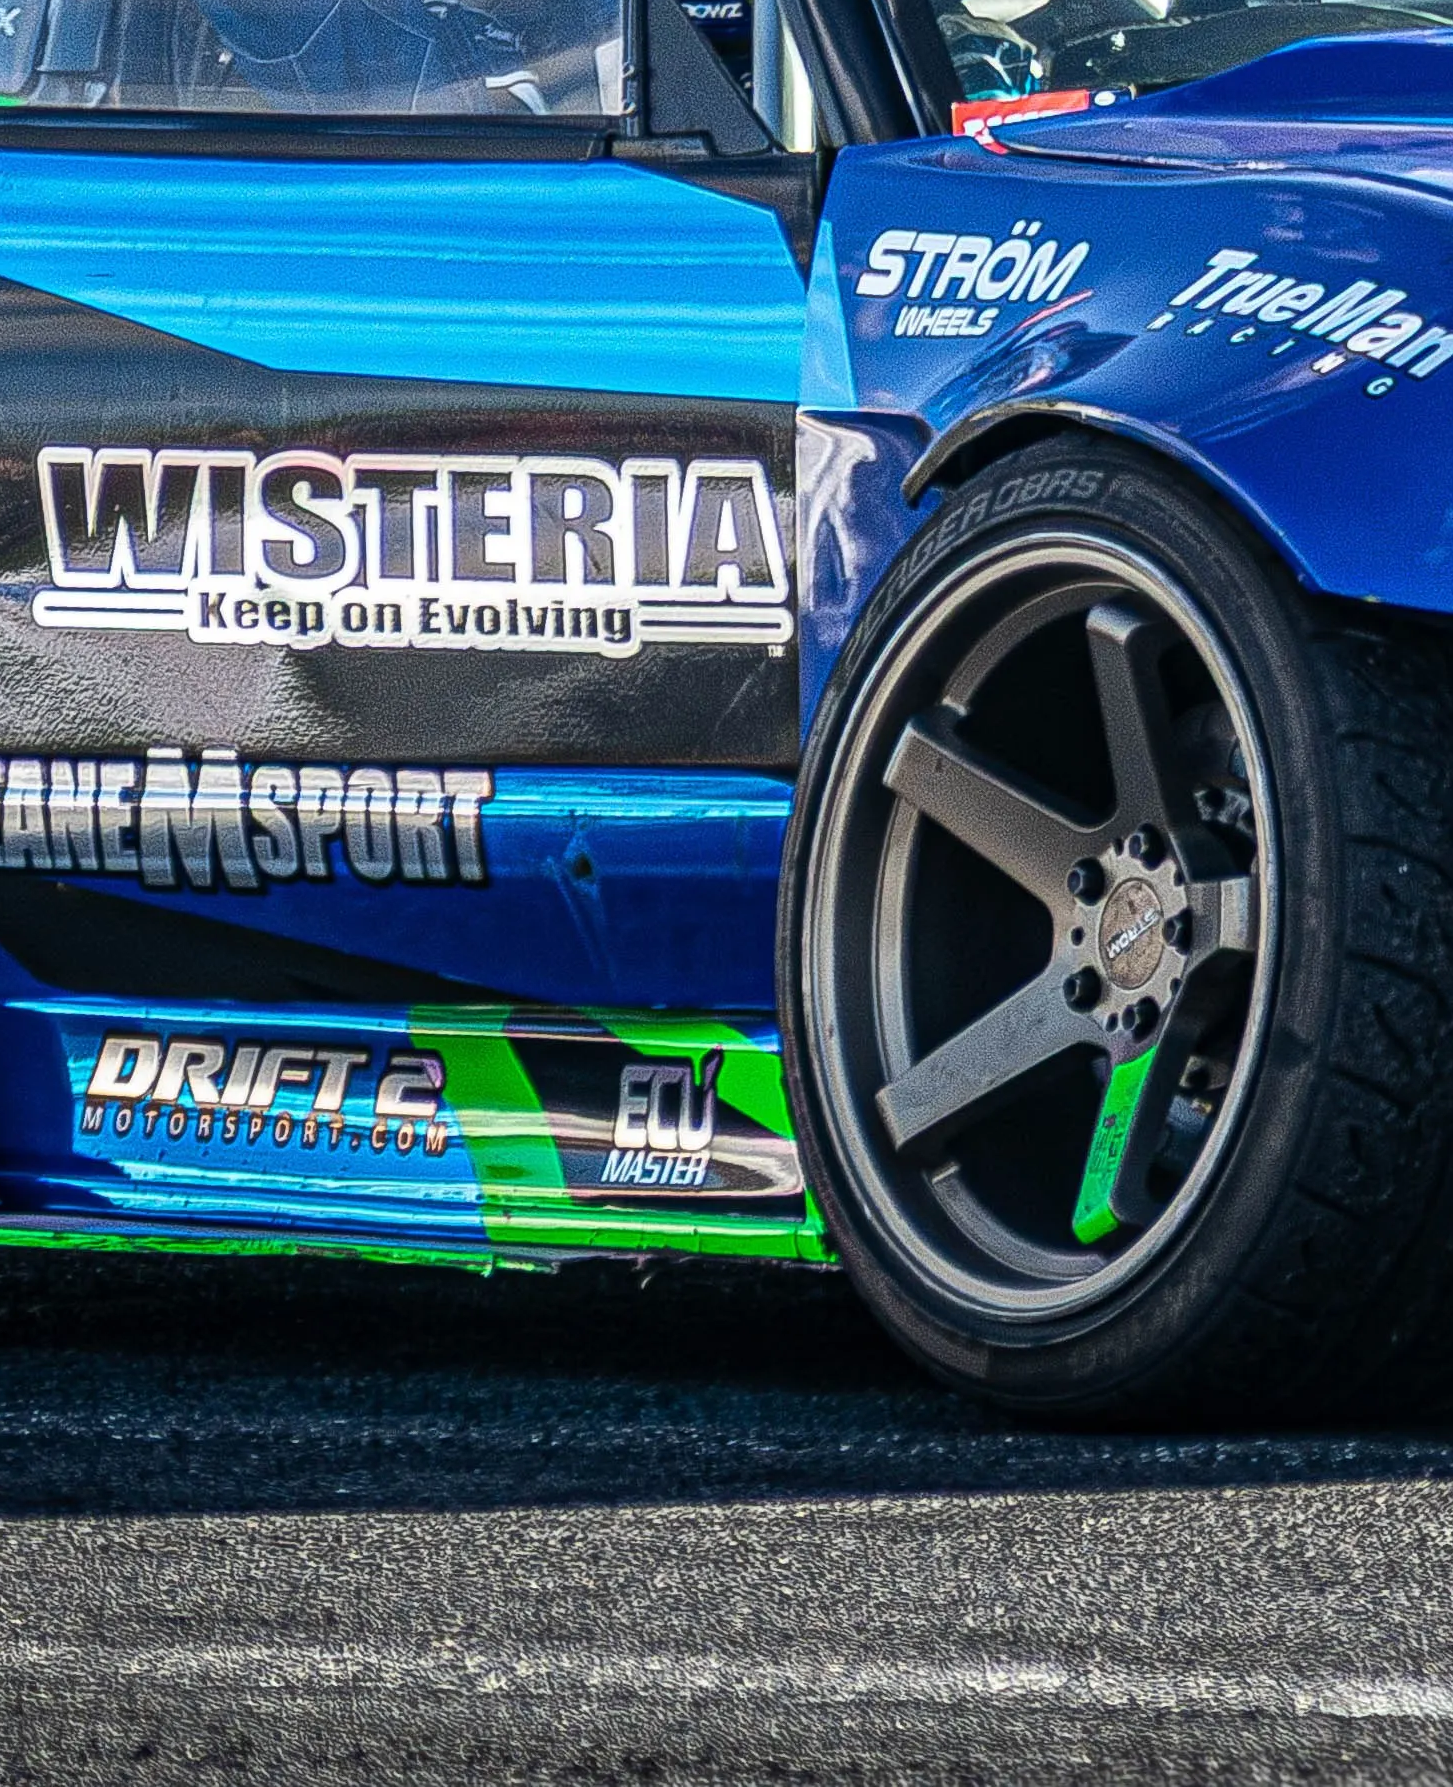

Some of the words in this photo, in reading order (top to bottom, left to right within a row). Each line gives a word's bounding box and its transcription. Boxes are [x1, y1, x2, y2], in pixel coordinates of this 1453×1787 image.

[856, 219, 1092, 304] STRÖM
[893, 305, 999, 338] WHEELS
[36, 446, 790, 602] WISTERIA
[196, 590, 325, 640] Keep
[347, 598, 404, 636] on
[420, 597, 633, 645] Evolving
[85, 1034, 367, 1113] DRIFT
[374, 1052, 447, 1119] 2
[613, 1045, 723, 1151] ECU
[82, 1106, 450, 1156] MOTORSPORT.COM
[601, 1149, 712, 1186] MASTER
